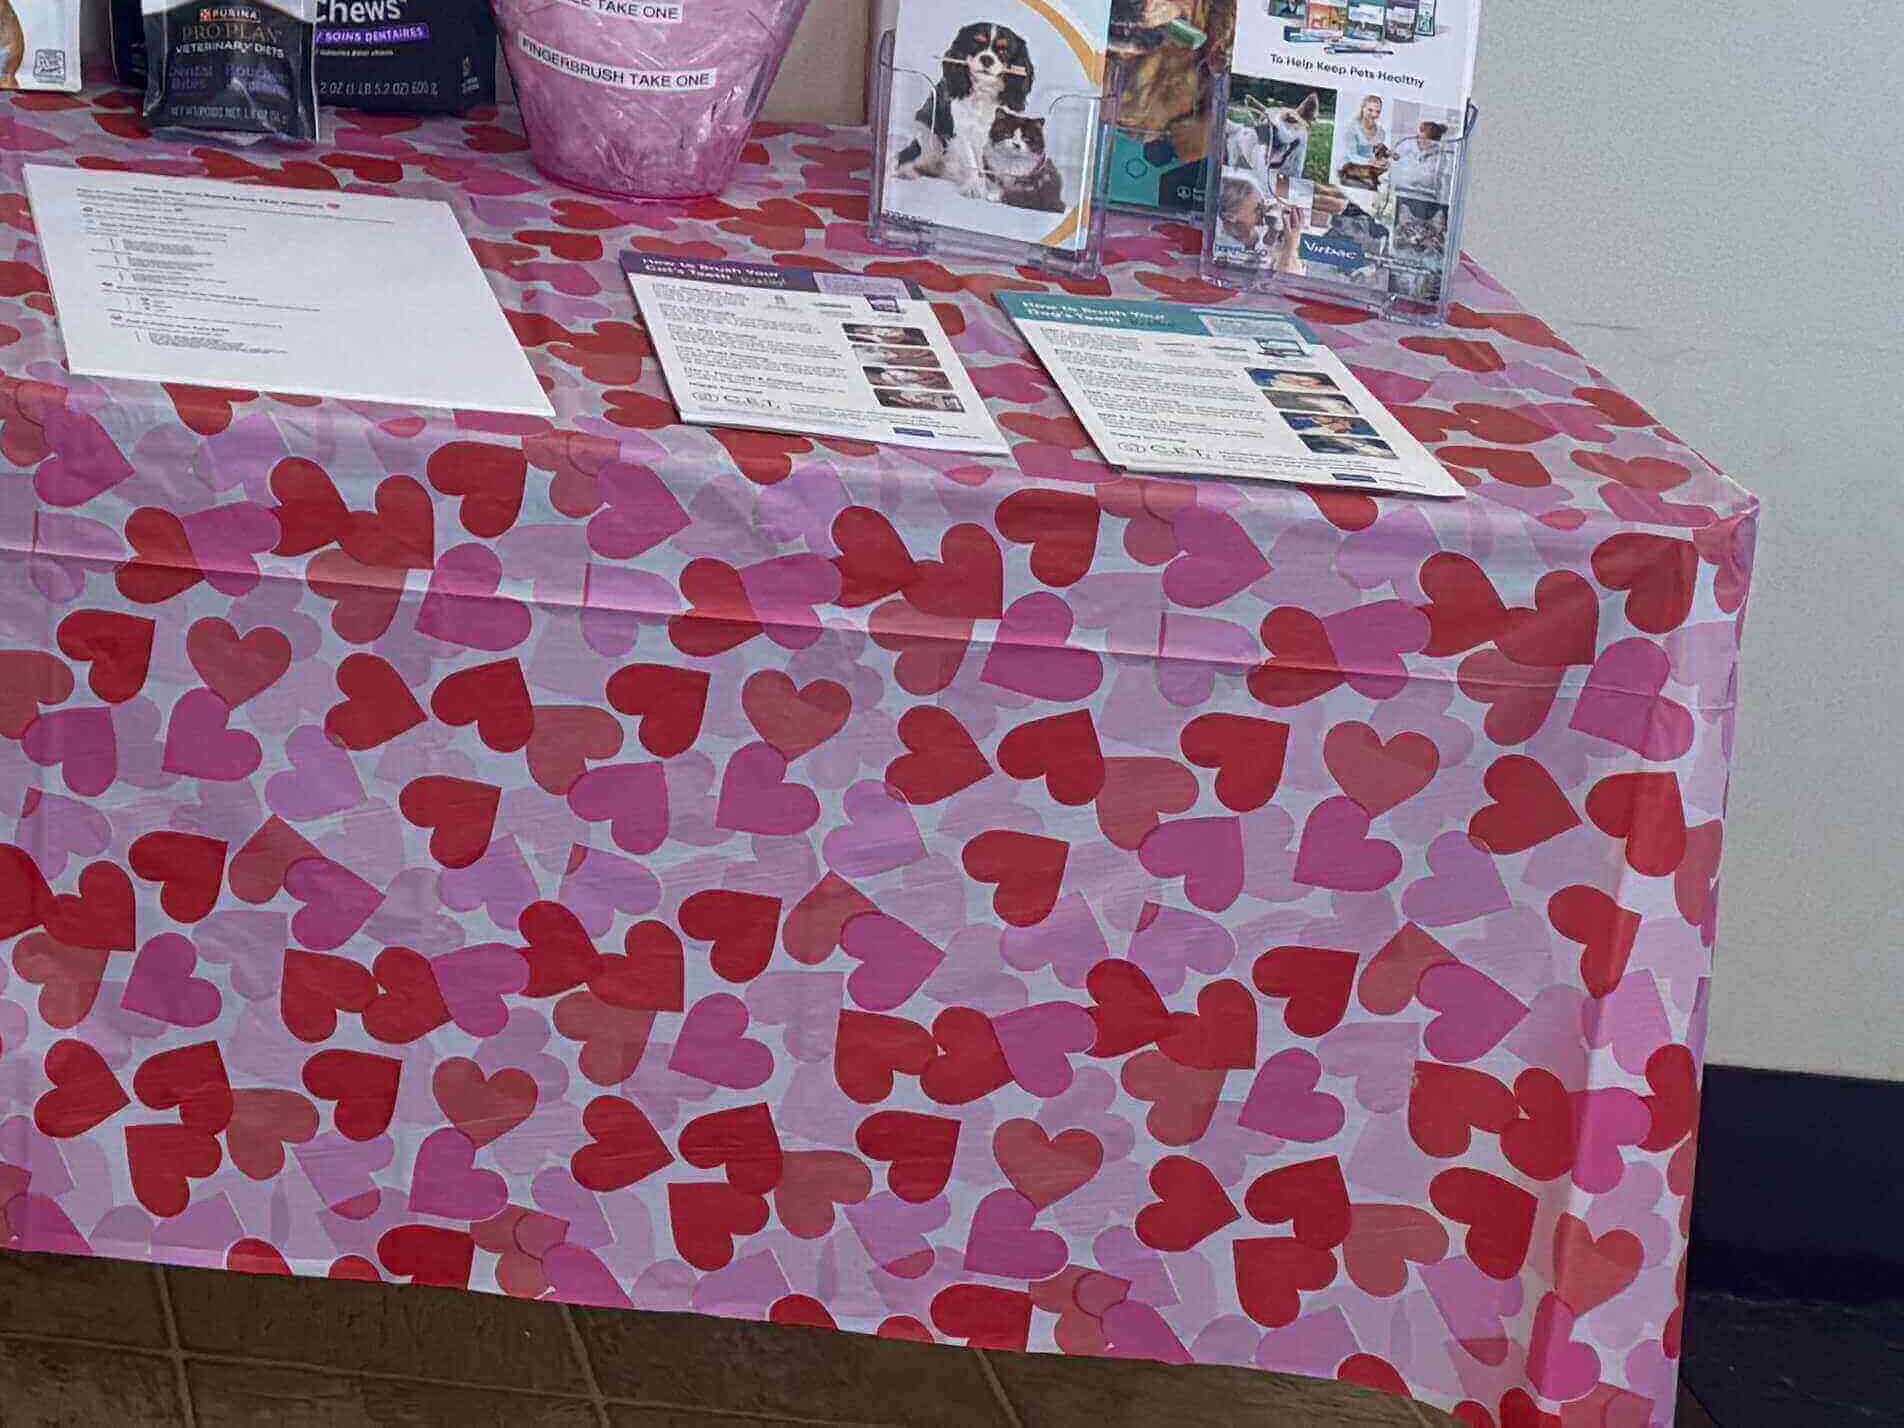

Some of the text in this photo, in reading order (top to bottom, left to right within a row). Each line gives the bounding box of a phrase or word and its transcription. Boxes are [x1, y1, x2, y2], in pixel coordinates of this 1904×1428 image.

[642, 5, 679, 20] ONE
[182, 23, 277, 43] PRO PLAN
[325, 26, 424, 44] SOINS DENTAIRES
[254, 44, 284, 59] DIETS
[522, 37, 711, 88] FINGERBRUSH TAKE ONE
[1270, 53, 1426, 89] To Help Keep Pets Healthy
[1304, 240, 1358, 260] Virbac
